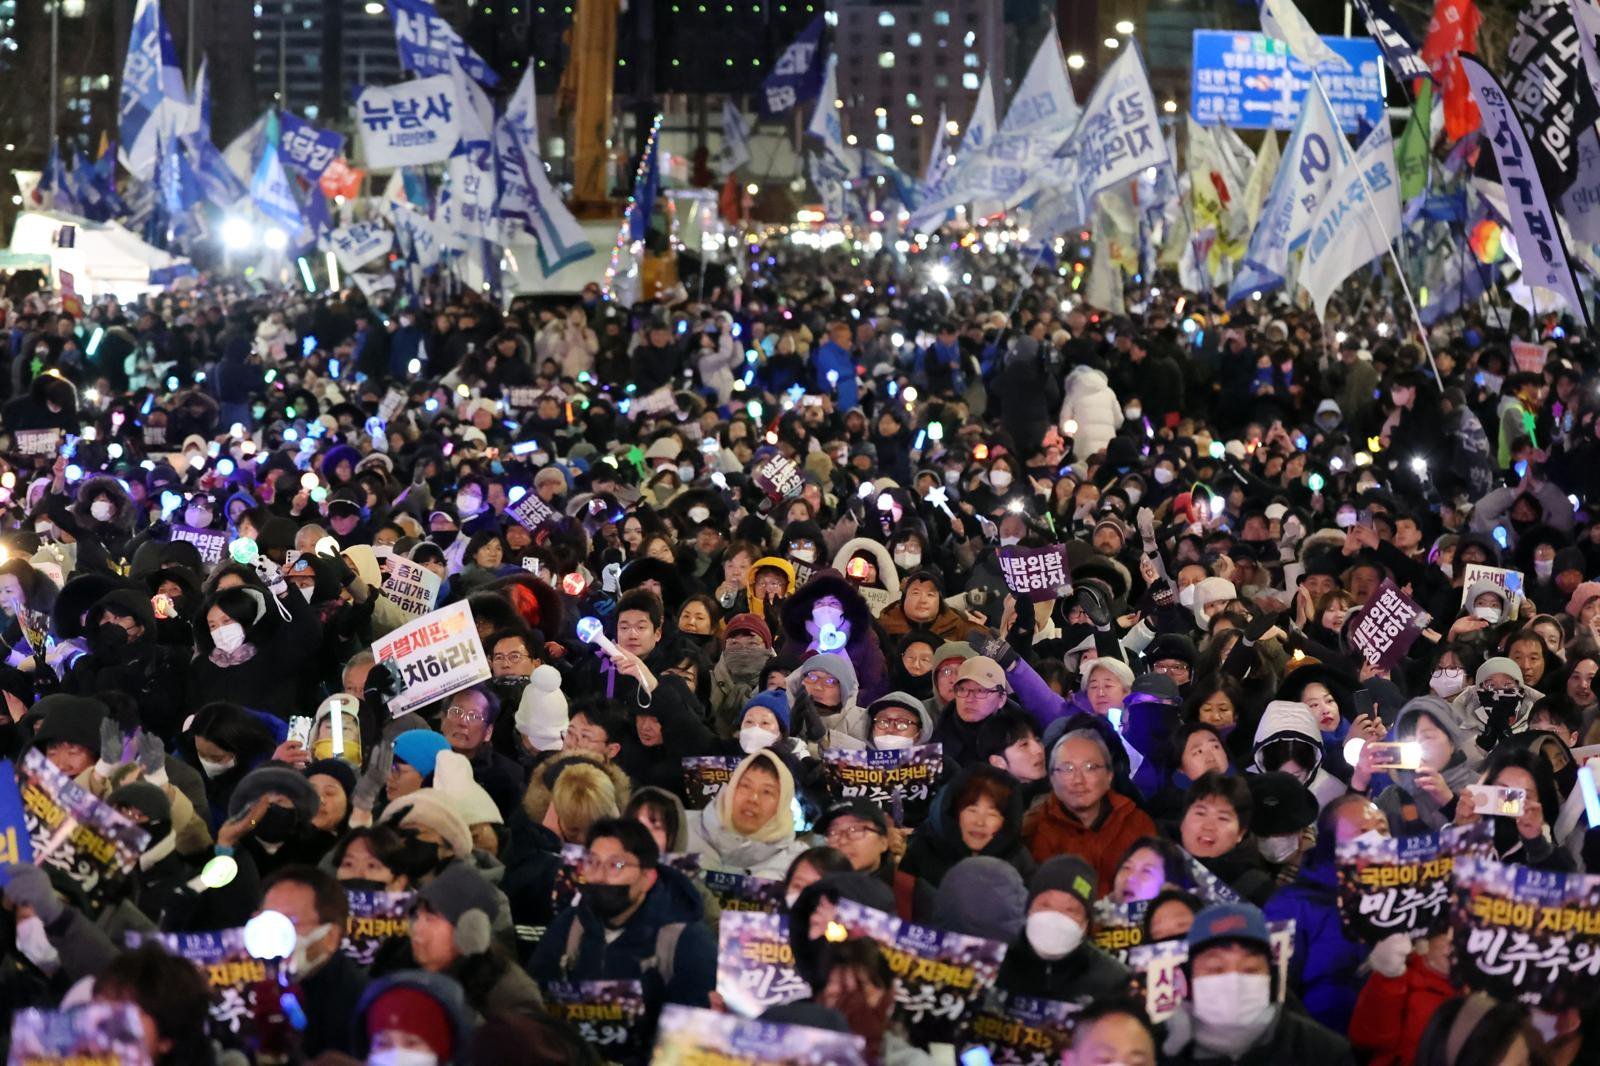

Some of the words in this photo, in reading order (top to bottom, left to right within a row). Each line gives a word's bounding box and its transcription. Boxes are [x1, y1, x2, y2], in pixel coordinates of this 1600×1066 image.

[363, 93, 452, 132] 뉴탐사
[514, 494, 544, 520] 란외환
[998, 551, 1063, 575] 내란외환
[1004, 568, 1066, 593] 청산하자
[1352, 588, 1403, 651] 내란외환
[1363, 601, 1417, 665] 청산하자
[397, 638, 478, 691] 치하라!
[703, 770, 734, 781] 국민
[841, 768, 883, 784] 국민이
[886, 764, 928, 781] 지켜낸
[1361, 865, 1418, 887] 국민이
[1359, 880, 1450, 928] 민주주
[1472, 895, 1535, 929] 국민이
[911, 958, 976, 989] 지켜낸
[1467, 927, 1600, 986] 민주주의
[741, 965, 812, 1007] 민주
[893, 978, 965, 1024] 주의
